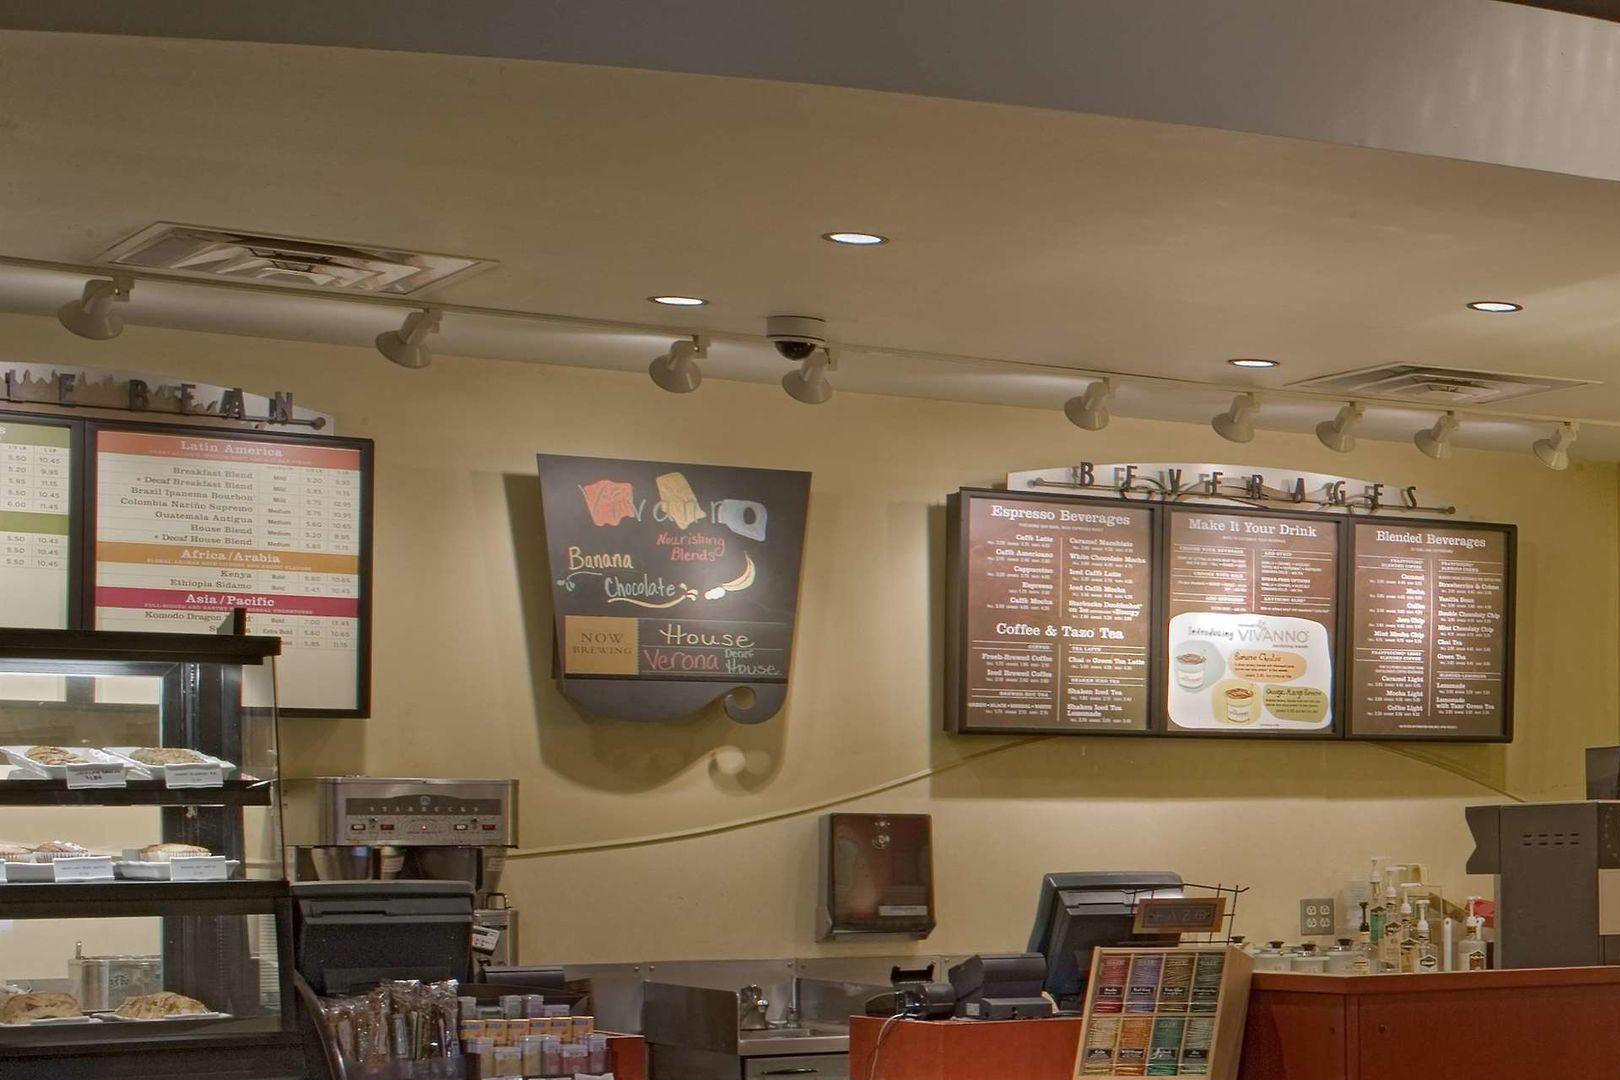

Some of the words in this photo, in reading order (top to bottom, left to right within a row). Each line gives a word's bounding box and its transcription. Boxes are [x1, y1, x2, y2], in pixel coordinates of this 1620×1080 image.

[181, 440, 218, 452] Latin
[224, 444, 283, 457] America
[173, 467, 221, 477] Breakfast
[145, 476, 172, 485] Decaf
[173, 478, 222, 488] Breakfast
[1079, 461, 1417, 511] BEVERAGES
[164, 489, 208, 500] Ipanema
[120, 498, 168, 507] Colombia
[155, 511, 208, 520] Guatemala
[213, 514, 253, 524] Antigua
[991, 504, 1056, 520] Espresso
[1060, 510, 1131, 526] Beverages
[190, 524, 220, 532] House
[224, 526, 252, 534] Blend
[1188, 518, 1226, 532] Make
[1230, 521, 1240, 532] It
[1244, 522, 1277, 534] Your
[1280, 524, 1317, 537] Drink
[190, 536, 220, 544] House
[656, 532, 726, 556] Nourishing
[1376, 530, 1422, 544] Blended
[1427, 534, 1486, 548] Beverages
[180, 550, 226, 561] Africa
[568, 546, 634, 570] Banana
[671, 547, 717, 562] Blends
[220, 570, 252, 578] Kenya
[170, 579, 212, 588] Ethiopia
[216, 580, 252, 589] Sidamo
[605, 573, 676, 598] Chocolate
[186, 594, 216, 605] Asia
[227, 596, 275, 608] Pacific
[145, 610, 184, 620] Komodo
[187, 612, 222, 622] Dragon
[659, 624, 755, 648] House
[996, 622, 1040, 636] Coffee
[1045, 625, 1058, 636] &
[1099, 628, 1124, 640] Tea
[1188, 626, 1234, 641] Introducing
[1238, 629, 1307, 643] VIVANNO
[581, 632, 623, 645] NOW
[573, 644, 633, 655] BREWING
[644, 650, 719, 671] Verona
[726, 659, 781, 675] House
